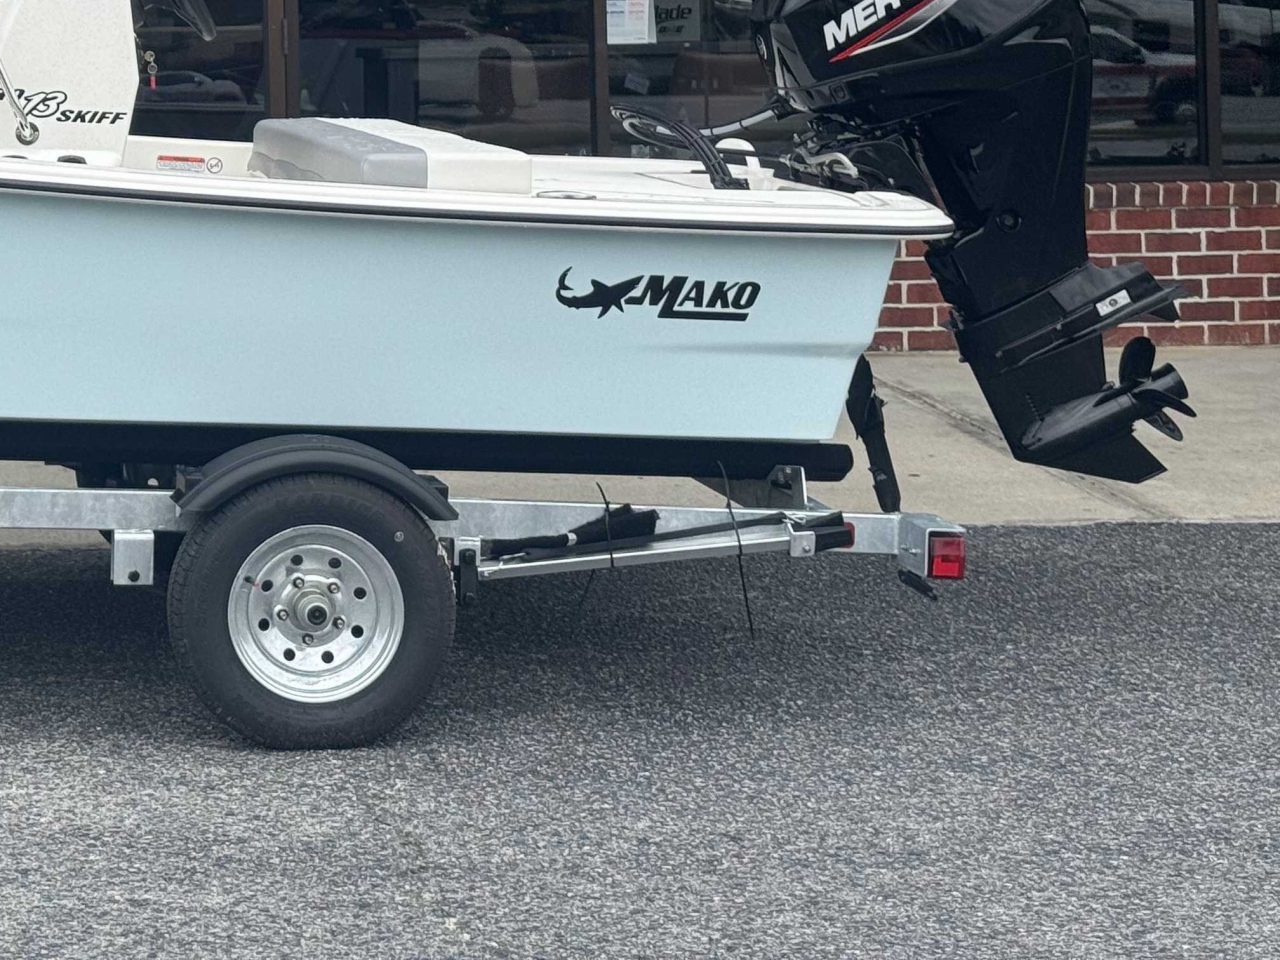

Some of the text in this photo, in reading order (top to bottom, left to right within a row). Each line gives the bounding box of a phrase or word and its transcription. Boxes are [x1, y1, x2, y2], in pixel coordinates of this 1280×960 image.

[655, 4, 692, 20] lade
[22, 90, 68, 118] 13
[56, 110, 128, 124] SKIFF
[624, 275, 761, 322] MAKO
